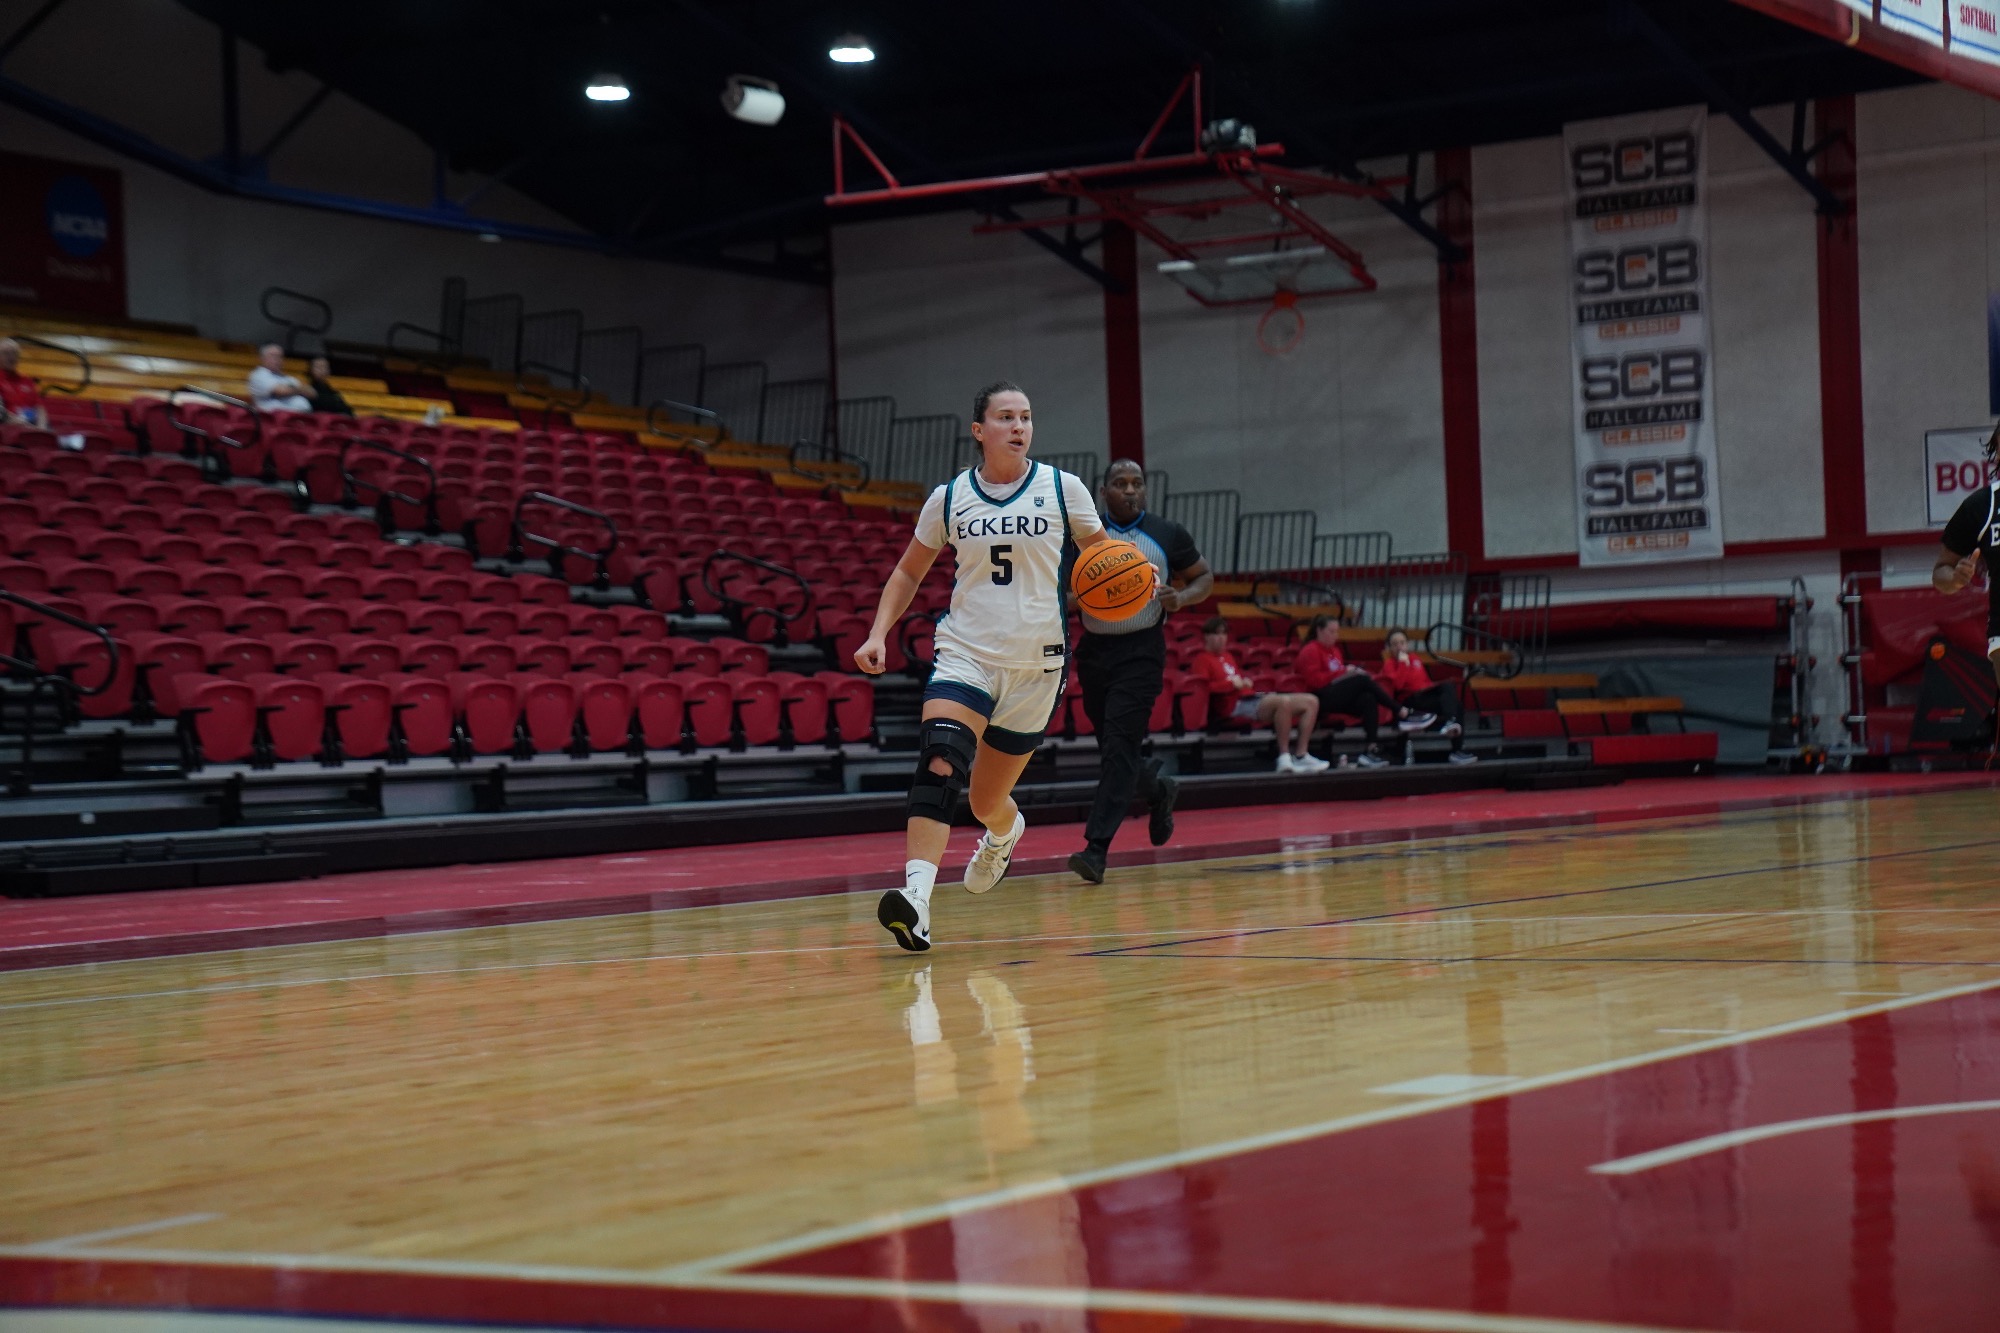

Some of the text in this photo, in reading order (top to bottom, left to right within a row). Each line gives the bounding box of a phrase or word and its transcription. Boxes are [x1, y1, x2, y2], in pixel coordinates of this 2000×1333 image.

[1960, 3, 1997, 35] SOFTBALL
[1573, 130, 1696, 188] SCB
[1577, 240, 1698, 294] SCB
[1583, 302, 1630, 321] HALL
[1643, 293, 1693, 314] FAME
[1582, 349, 1702, 400] SCB
[1589, 409, 1634, 427] HALL
[1647, 402, 1697, 420] FAME
[1585, 457, 1706, 507] SCB
[957, 516, 1048, 539] ECKERD
[1592, 516, 1638, 533] HALL
[1652, 510, 1701, 528] FAME
[1609, 533, 1689, 552] CLASSIC
[990, 545, 1012, 585] 5
[1085, 552, 1138, 581] Wilson
[1106, 573, 1143, 600] NCAA
